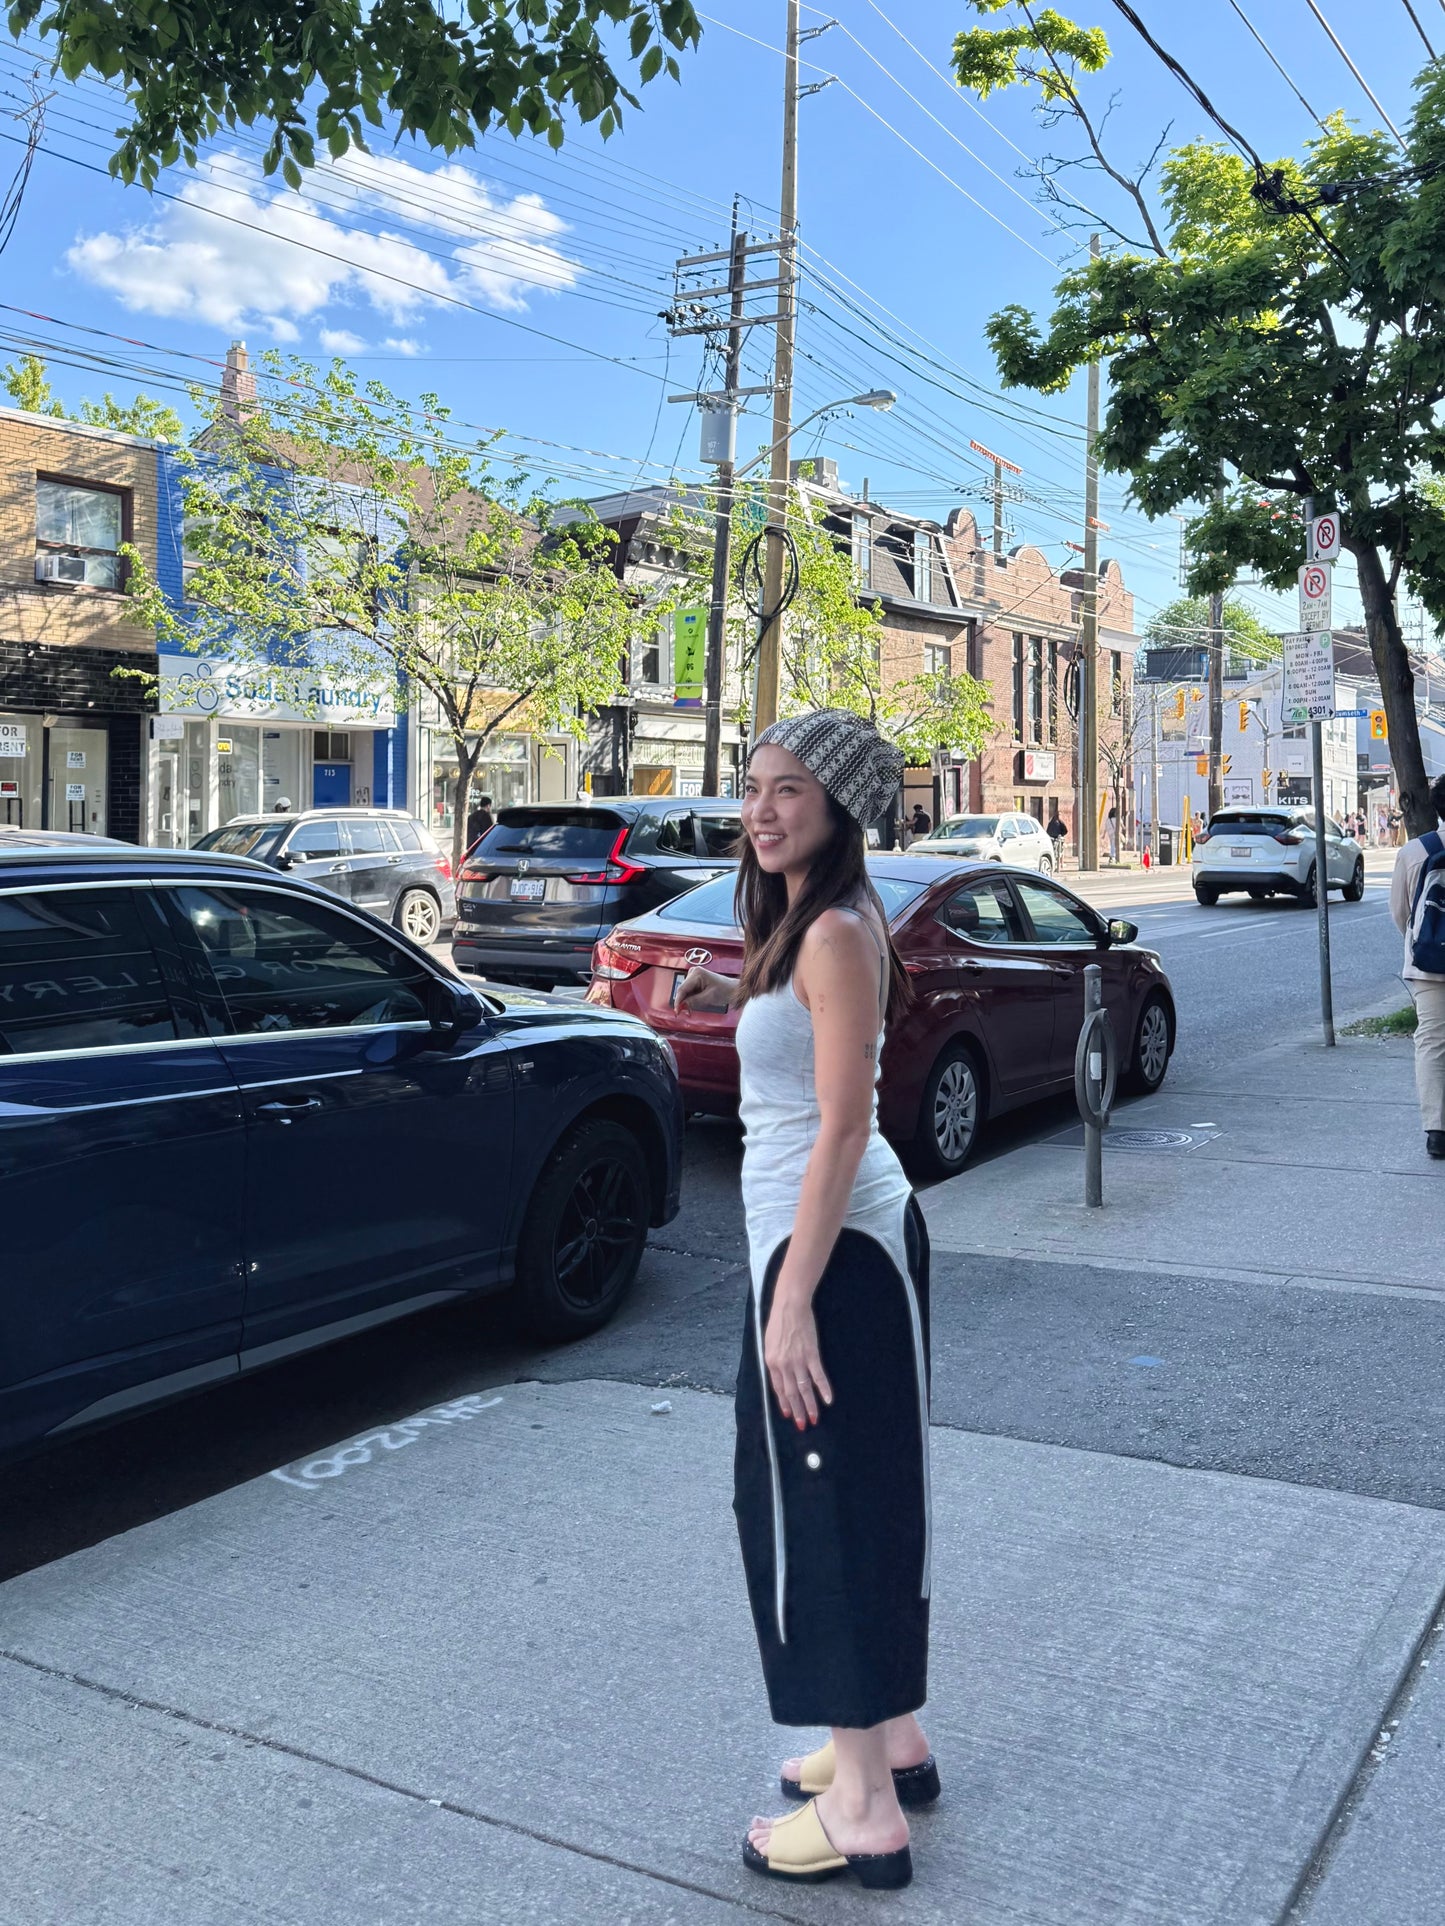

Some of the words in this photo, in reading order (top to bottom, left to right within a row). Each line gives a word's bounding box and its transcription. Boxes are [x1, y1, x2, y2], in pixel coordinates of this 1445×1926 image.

[1321, 610, 1329, 620] BY
[1307, 705, 1326, 715] 4301
[682, 783, 702, 796] FOR
[1278, 796, 1308, 805] KITS
